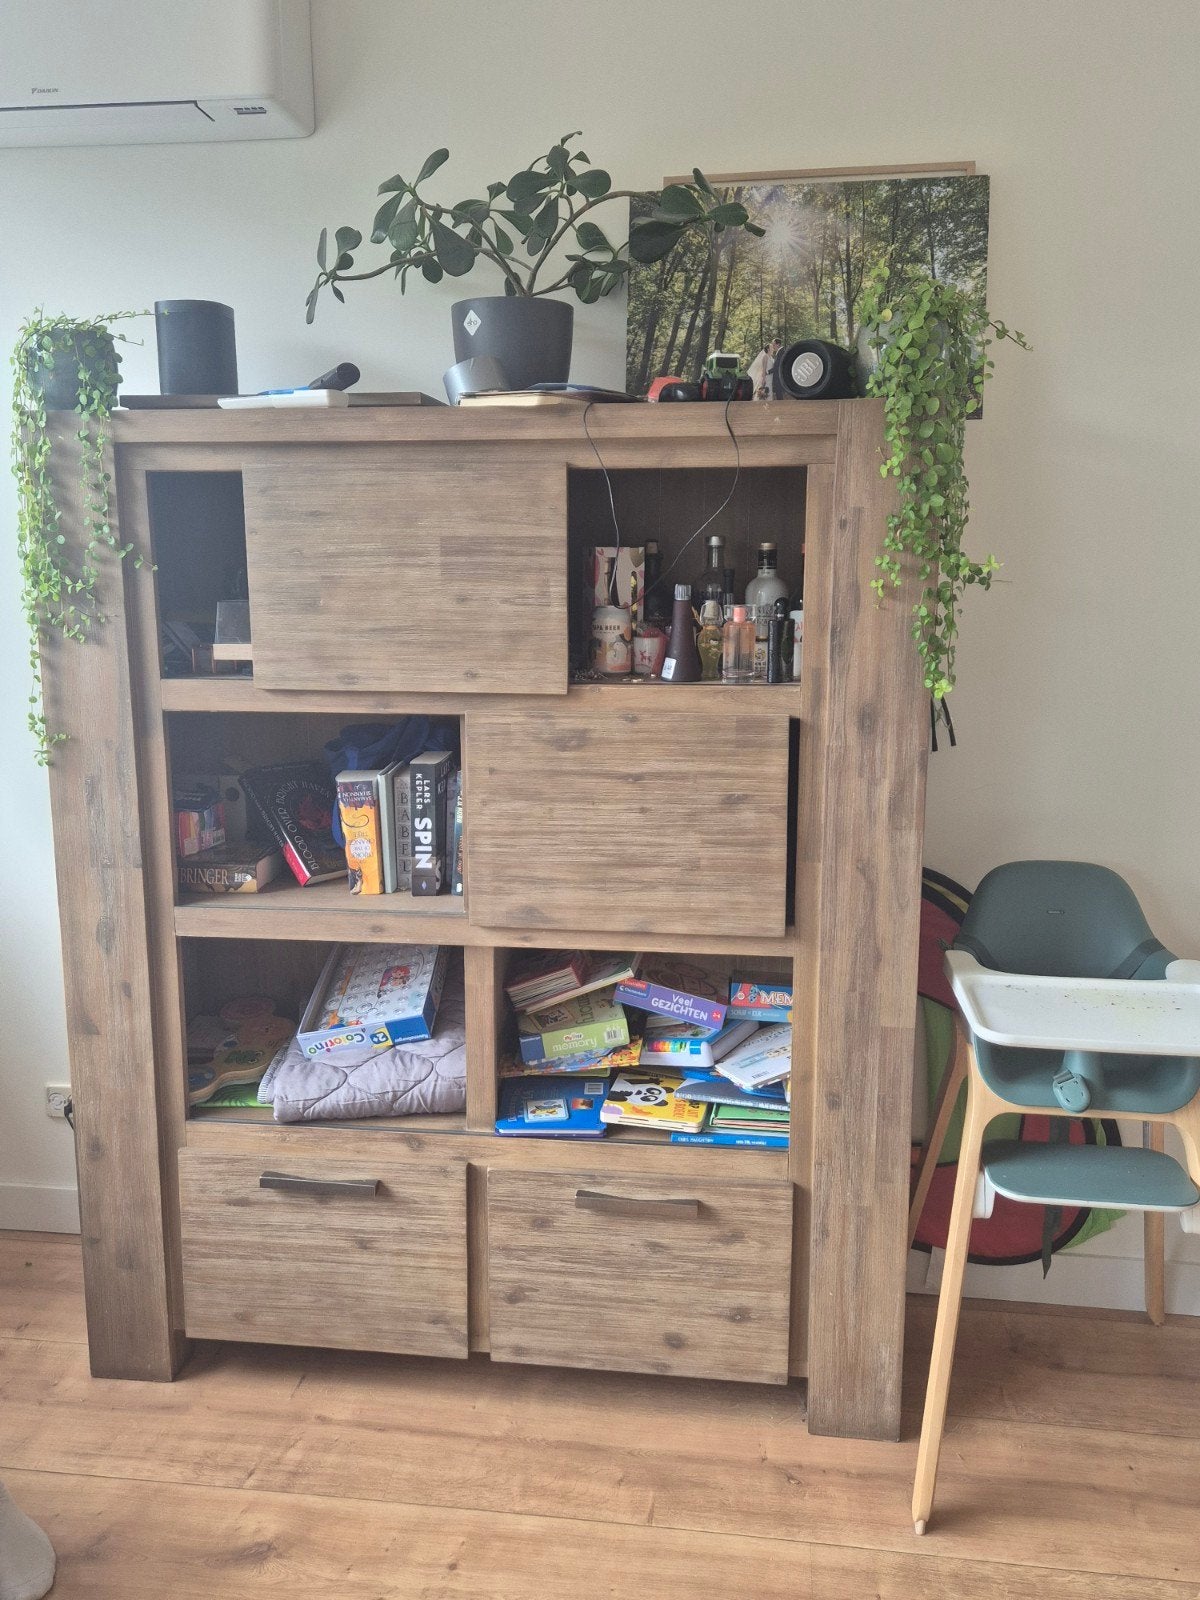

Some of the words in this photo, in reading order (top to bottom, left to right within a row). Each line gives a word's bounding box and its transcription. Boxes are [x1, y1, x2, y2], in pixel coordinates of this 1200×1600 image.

[797, 358, 820, 382] JBL
[415, 773, 423, 810] KEPLER
[423, 780, 431, 804] LARS
[294, 835, 321, 871] BLOOD
[414, 818, 433, 869] SPIN
[651, 997, 708, 1021] GEZICHTEN
[672, 993, 693, 1007] Veel
[308, 1033, 365, 1054] Colorino
[552, 1038, 597, 1052] memory
